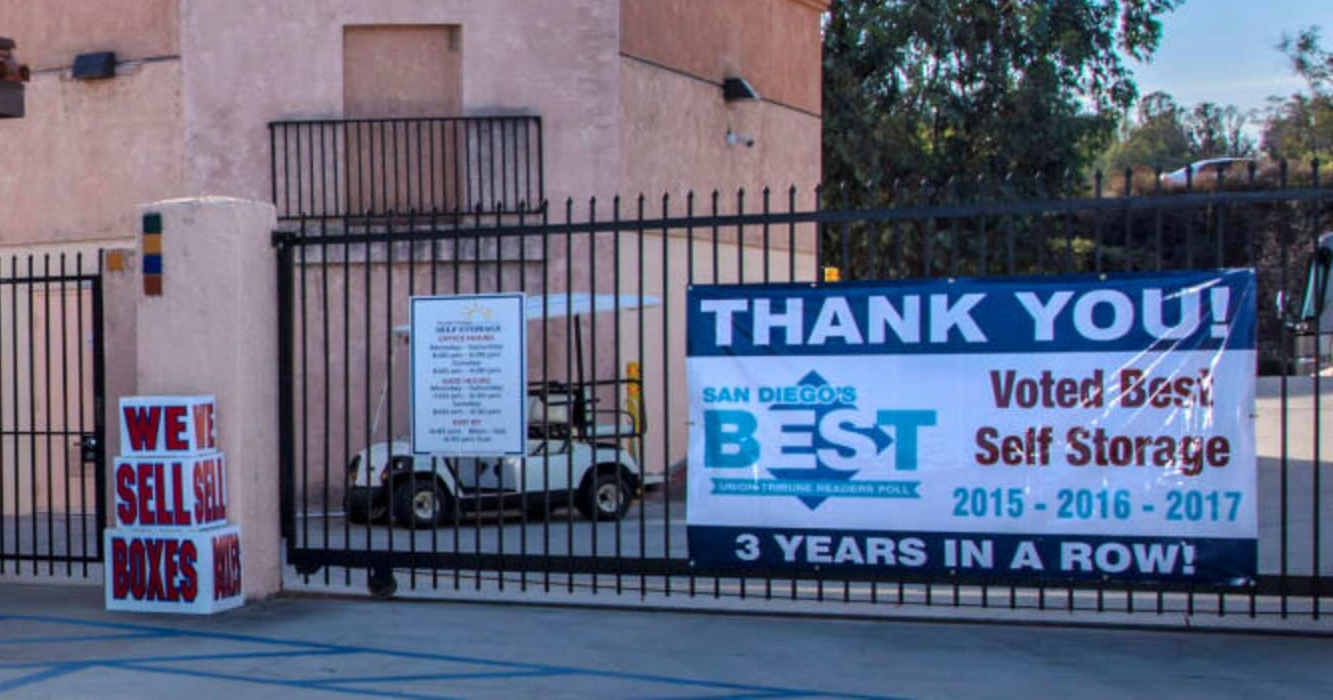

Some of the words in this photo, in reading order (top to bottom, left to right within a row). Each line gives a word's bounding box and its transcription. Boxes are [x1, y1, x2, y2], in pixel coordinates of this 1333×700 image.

[700, 292, 988, 346] THANK
[1015, 286, 1231, 343] YOU!
[702, 386, 750, 403] SAN
[758, 384, 858, 404] DIEGO'S
[989, 368, 1105, 409] Voted
[1120, 368, 1215, 409] Best
[122, 405, 190, 451] WE
[192, 403, 215, 449] WE
[703, 408, 937, 471] BEST
[974, 426, 1054, 467] Self
[1065, 426, 1231, 477] Storage
[116, 461, 192, 526] SELL
[192, 457, 227, 525] SELL
[877, 485, 911, 496] POLL
[952, 487, 1025, 517] 2015
[1056, 488, 1132, 520] 2016
[1165, 490, 1242, 521] 2017
[111, 537, 198, 602] BOXES
[735, 534, 761, 561] 3
[775, 535, 928, 567] YEARS
[944, 539, 994, 568] IN
[1009, 541, 1045, 570] A
[1060, 541, 1196, 574] ROW!
